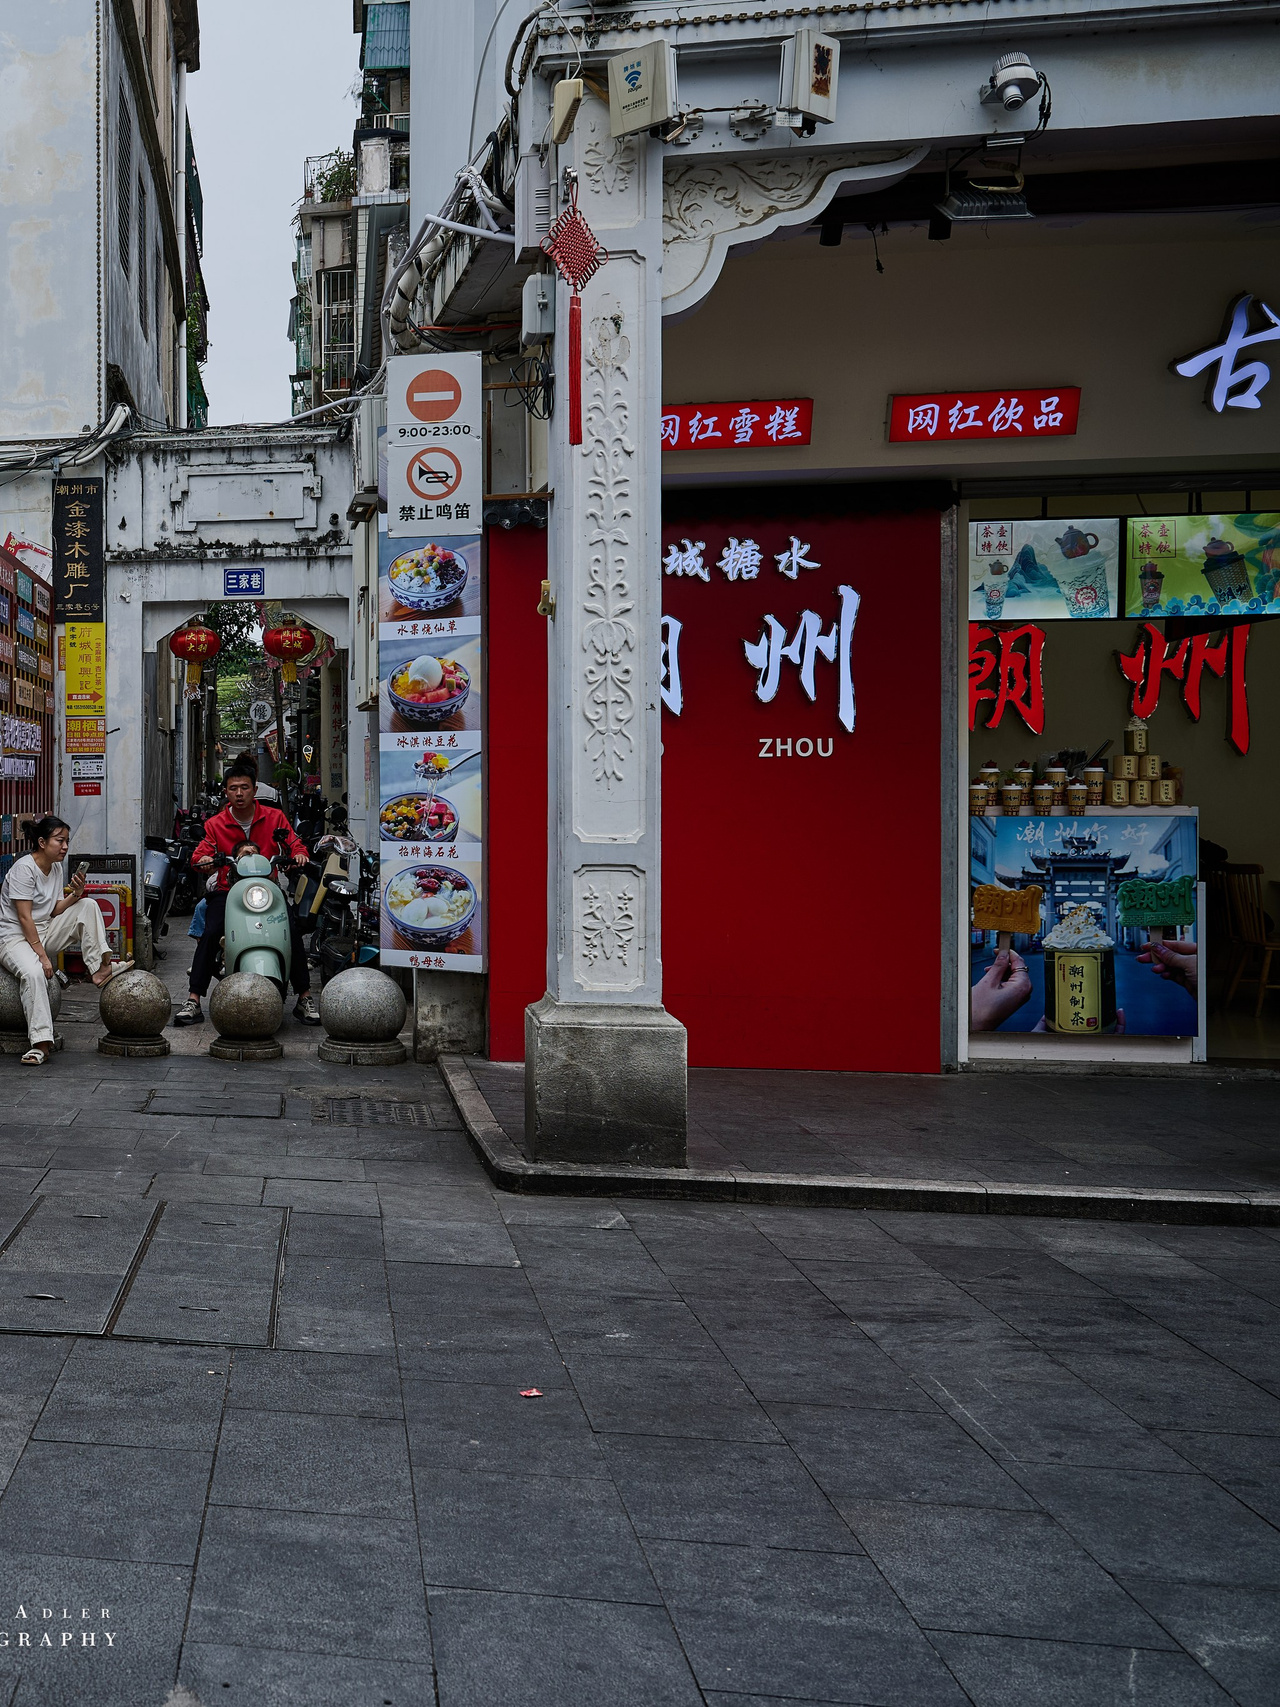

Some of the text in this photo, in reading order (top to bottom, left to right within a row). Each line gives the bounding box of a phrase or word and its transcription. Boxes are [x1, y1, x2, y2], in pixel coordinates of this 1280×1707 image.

[906, 395, 1065, 436] 网红饮品
[398, 424, 471, 438] 9:00-23:00
[660, 405, 802, 447] 网红雪糕
[56, 484, 99, 496] 潮州市
[399, 503, 471, 522] 禁止鸣笛
[981, 524, 1009, 538] 茶壶
[1138, 522, 1170, 538] 茶壶
[63, 500, 91, 599] 金漆木雕厂
[981, 540, 1010, 553] 特饮
[1138, 540, 1172, 555] 特饮
[662, 535, 822, 583] 城糖水
[227, 574, 261, 589] 三家巷
[55, 603, 100, 611] 三家巷5号
[397, 620, 458, 636] 水果烧仙草
[187, 632, 207, 642] 大吉
[187, 643, 208, 653] 大利
[78, 626, 93, 691] 府城順興記
[67, 720, 97, 731] 潮栖
[396, 734, 459, 748] 冰淇淋豆花
[758, 737, 834, 758] ZHOU
[1016, 820, 1150, 846] 潮州你好
[398, 845, 459, 859] 招牌海石花
[1024, 847, 1062, 857] Hello
[1122, 876, 1193, 914] 潮州
[1068, 964, 1085, 1026] 潮州制茶
